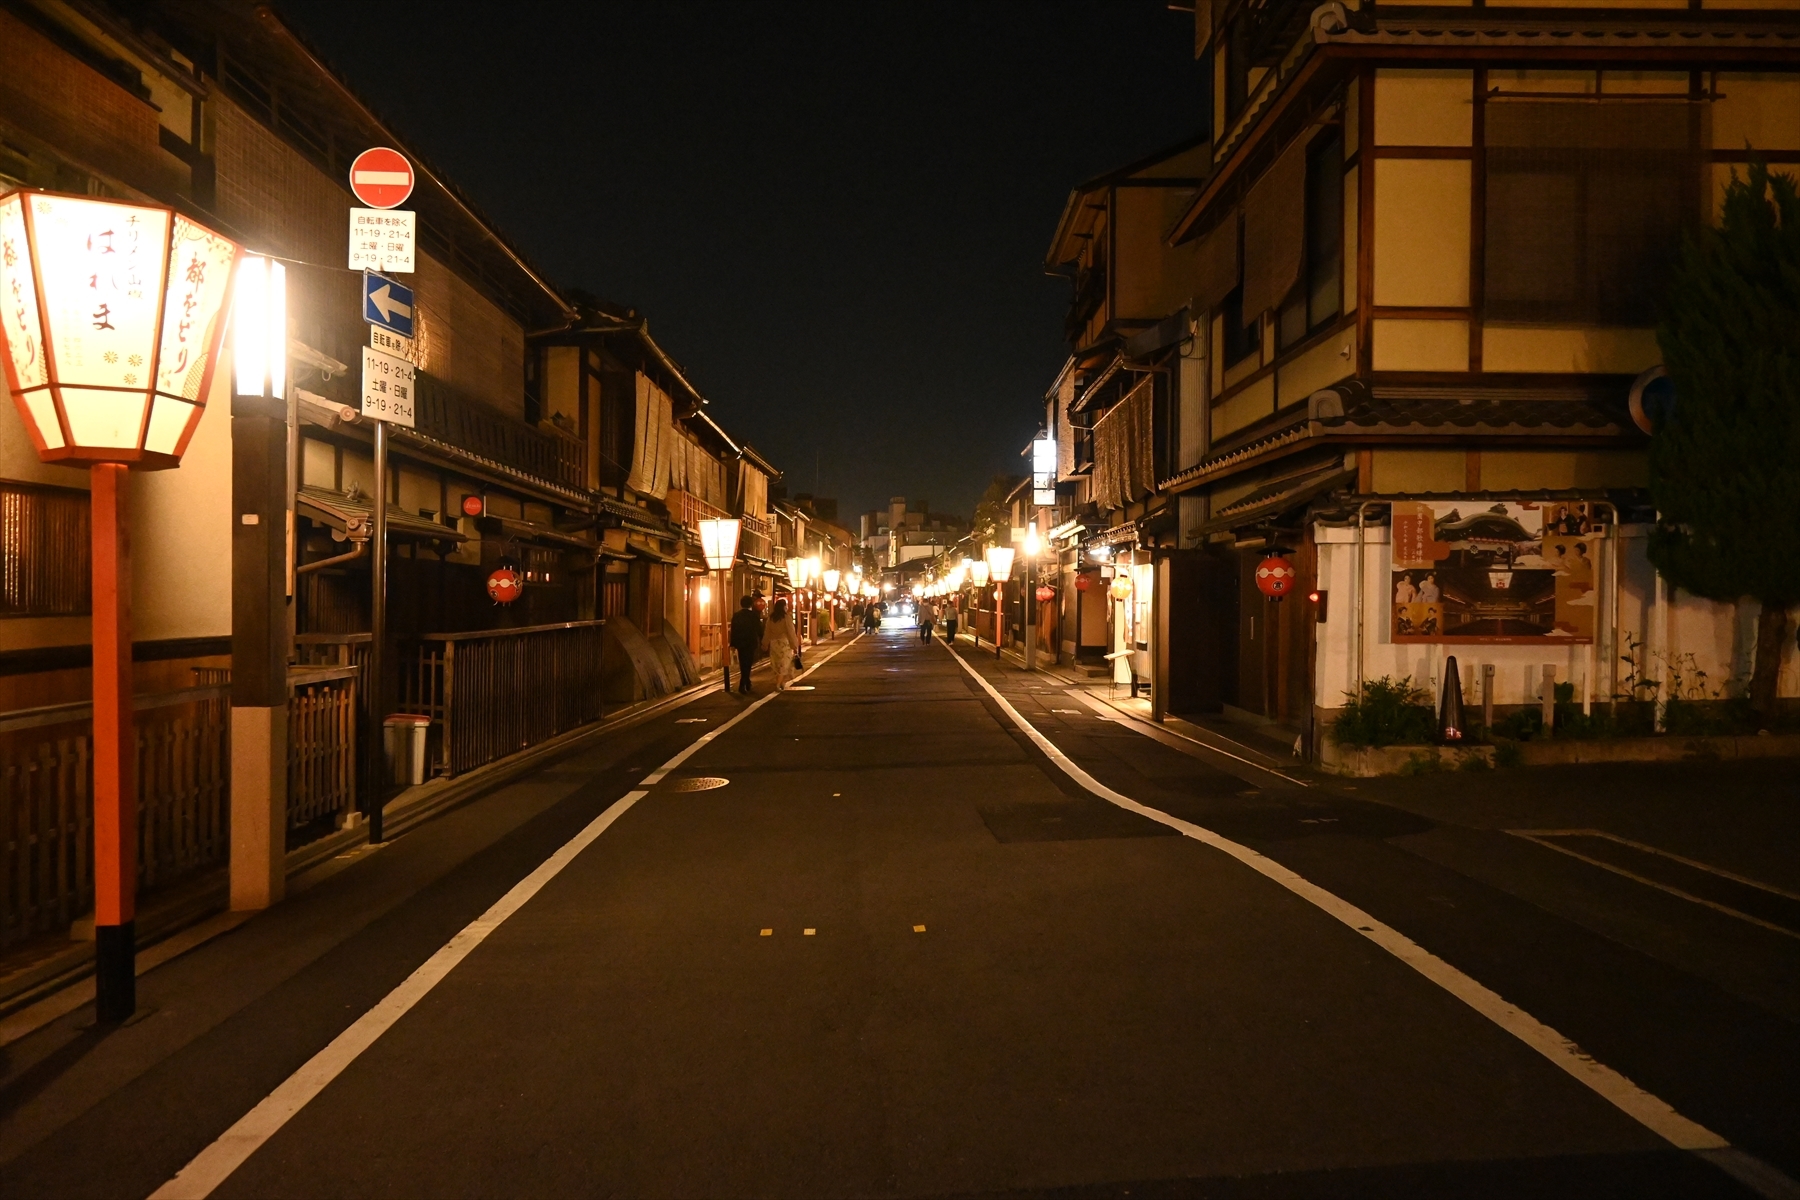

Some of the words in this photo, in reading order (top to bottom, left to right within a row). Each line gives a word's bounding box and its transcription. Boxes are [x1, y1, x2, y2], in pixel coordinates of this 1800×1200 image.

[357, 215, 408, 227] 自転車を除く
[86, 228, 119, 331] はれま
[173, 251, 207, 374] 都をどり
[373, 331, 406, 354] 自転車を除く
